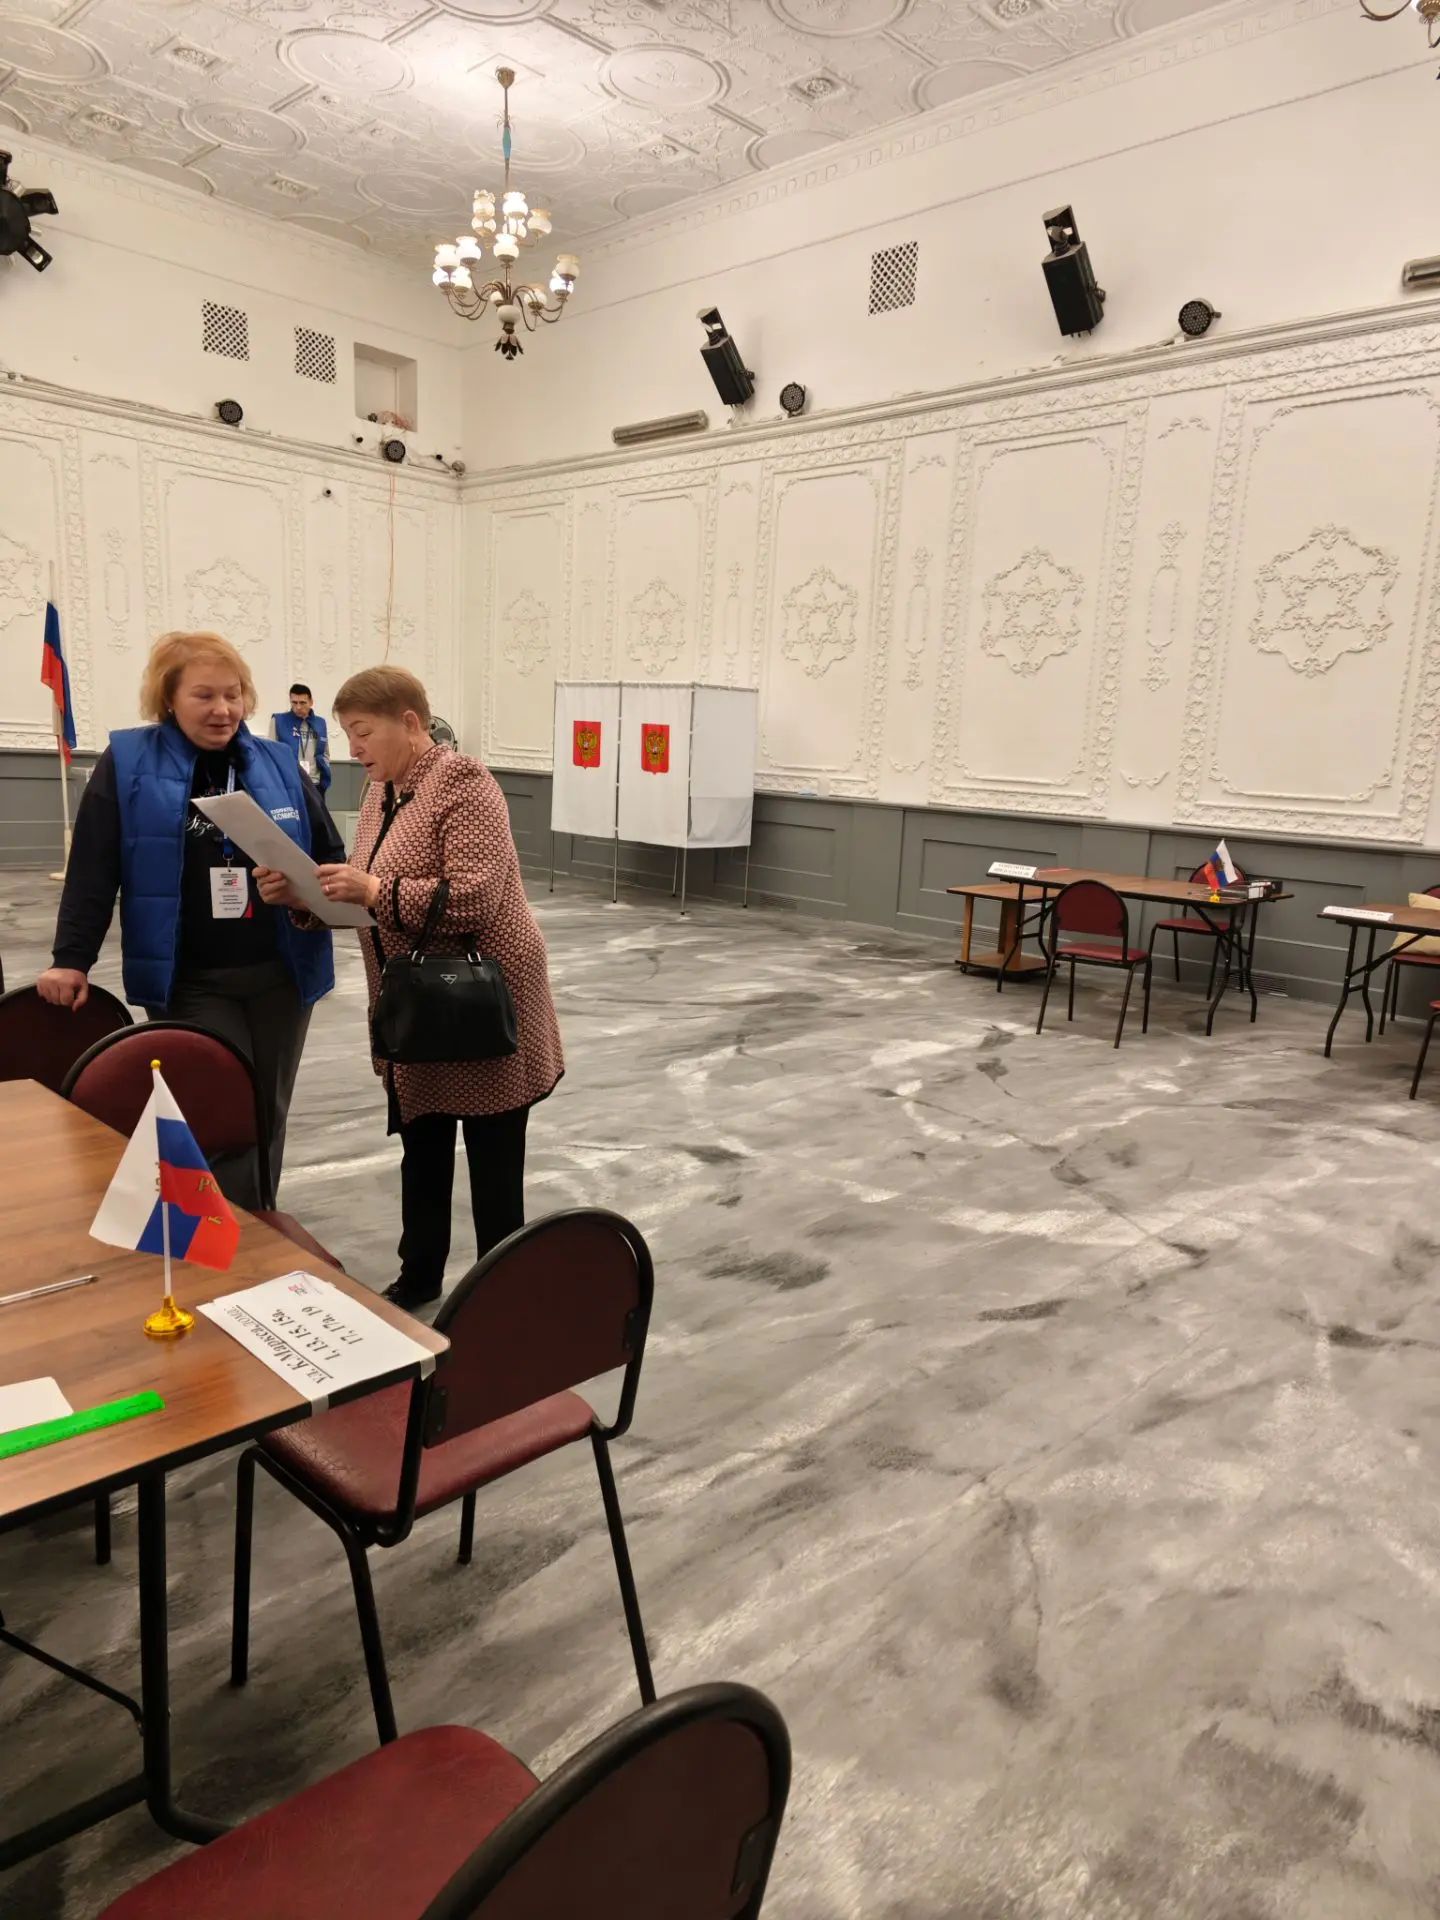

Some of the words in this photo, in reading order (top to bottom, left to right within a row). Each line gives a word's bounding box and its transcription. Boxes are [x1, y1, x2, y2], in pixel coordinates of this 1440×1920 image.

[301, 1305, 324, 1317] 19
[306, 1337, 329, 1352] 13,
[340, 1329, 364, 1345] 17,
